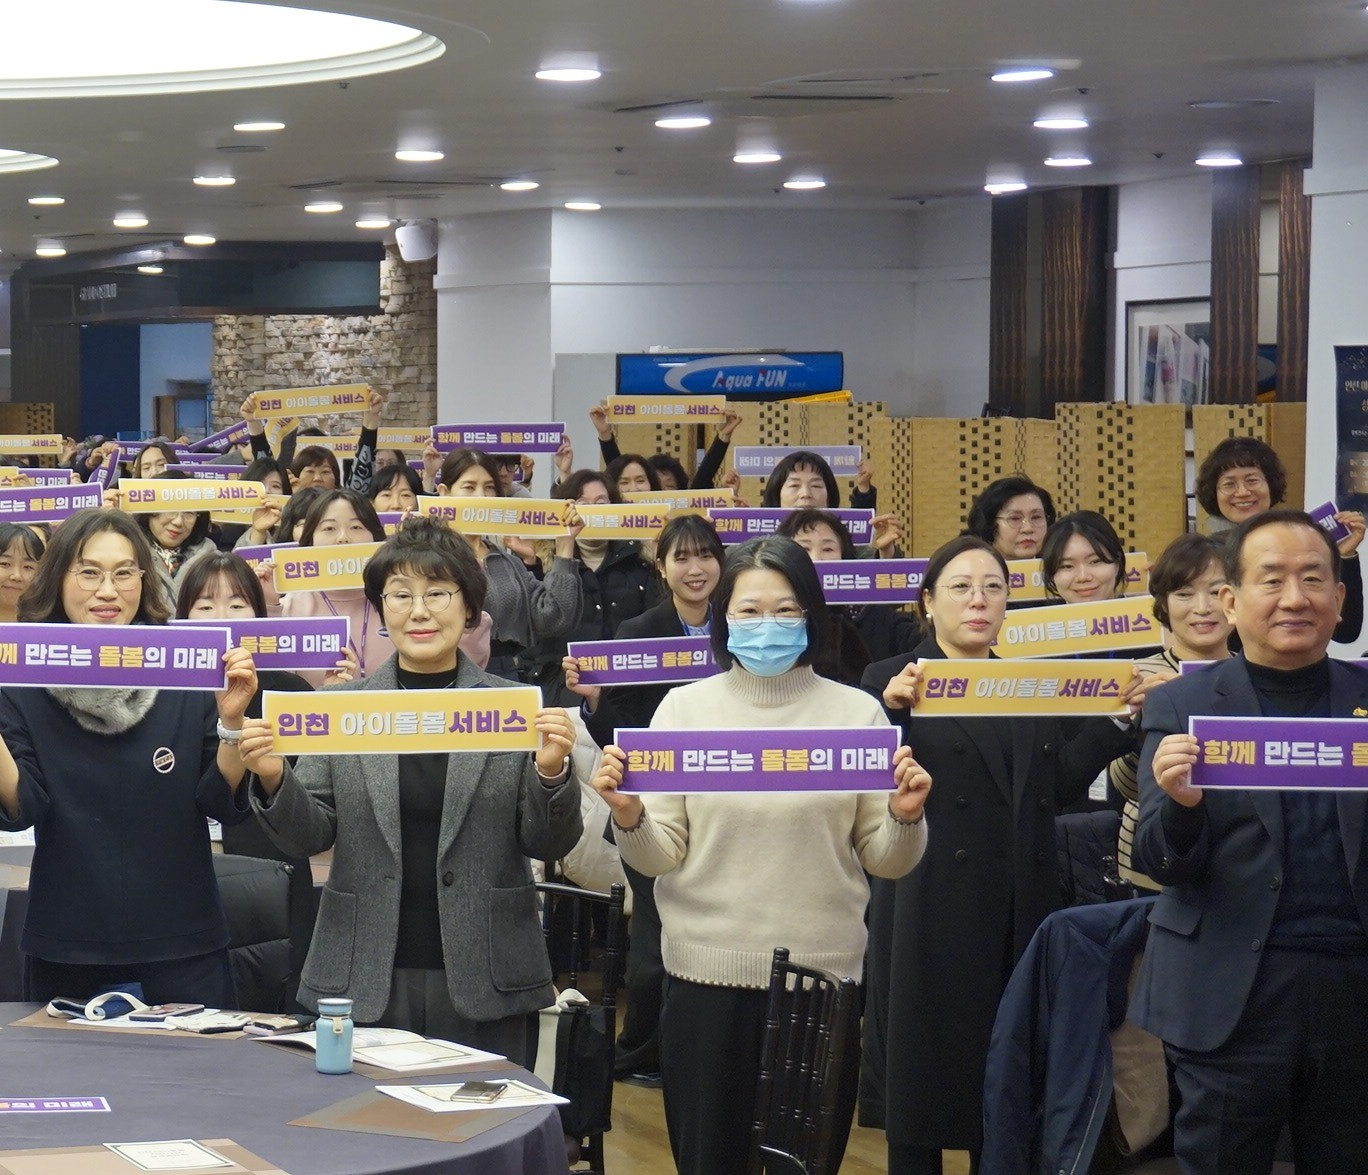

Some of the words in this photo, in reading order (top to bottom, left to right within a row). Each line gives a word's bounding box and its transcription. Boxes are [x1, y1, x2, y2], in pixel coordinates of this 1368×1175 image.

[711, 370, 753, 390] Aqua
[756, 369, 787, 388] FUN
[259, 398, 282, 411] 인천
[613, 404, 636, 415] 인천
[437, 432, 461, 443] 함께
[463, 432, 498, 443] 만드는
[500, 431, 535, 443] 돌봄의
[537, 431, 560, 443] 미래
[47, 476, 68, 487] 미래
[29, 496, 70, 511] 돌봄의
[72, 494, 99, 508] 미래
[128, 489, 156, 503] 인천
[428, 506, 457, 521] 인천
[462, 507, 560, 526] 아이돌봄서비스
[715, 518, 743, 533] 함께
[841, 518, 867, 534] 래
[284, 561, 320, 579] 인천
[822, 574, 871, 590] 만드는
[874, 572, 923, 589] 돌봄의
[1009, 572, 1025, 588] 천
[239, 635, 297, 654] 돌봄의
[302, 634, 340, 652] 미래
[24, 644, 93, 667] 만드는
[98, 645, 166, 669] 돌봄의
[172, 647, 218, 670] 미래
[578, 655, 608, 671] 함께
[612, 652, 658, 669] 만드는
[661, 650, 708, 668] 돌봄의
[925, 678, 967, 699] 인천
[974, 677, 1120, 699] 아이돌봄서비스
[278, 713, 330, 737] 인천
[340, 709, 528, 735] 아이돌봄서비스
[627, 750, 674, 772] 함께
[682, 749, 754, 771] 만드는
[760, 748, 833, 771] 돌봄의
[840, 747, 889, 771] 미래
[1203, 739, 1256, 766] 함께
[1264, 740, 1344, 766] 만드는
